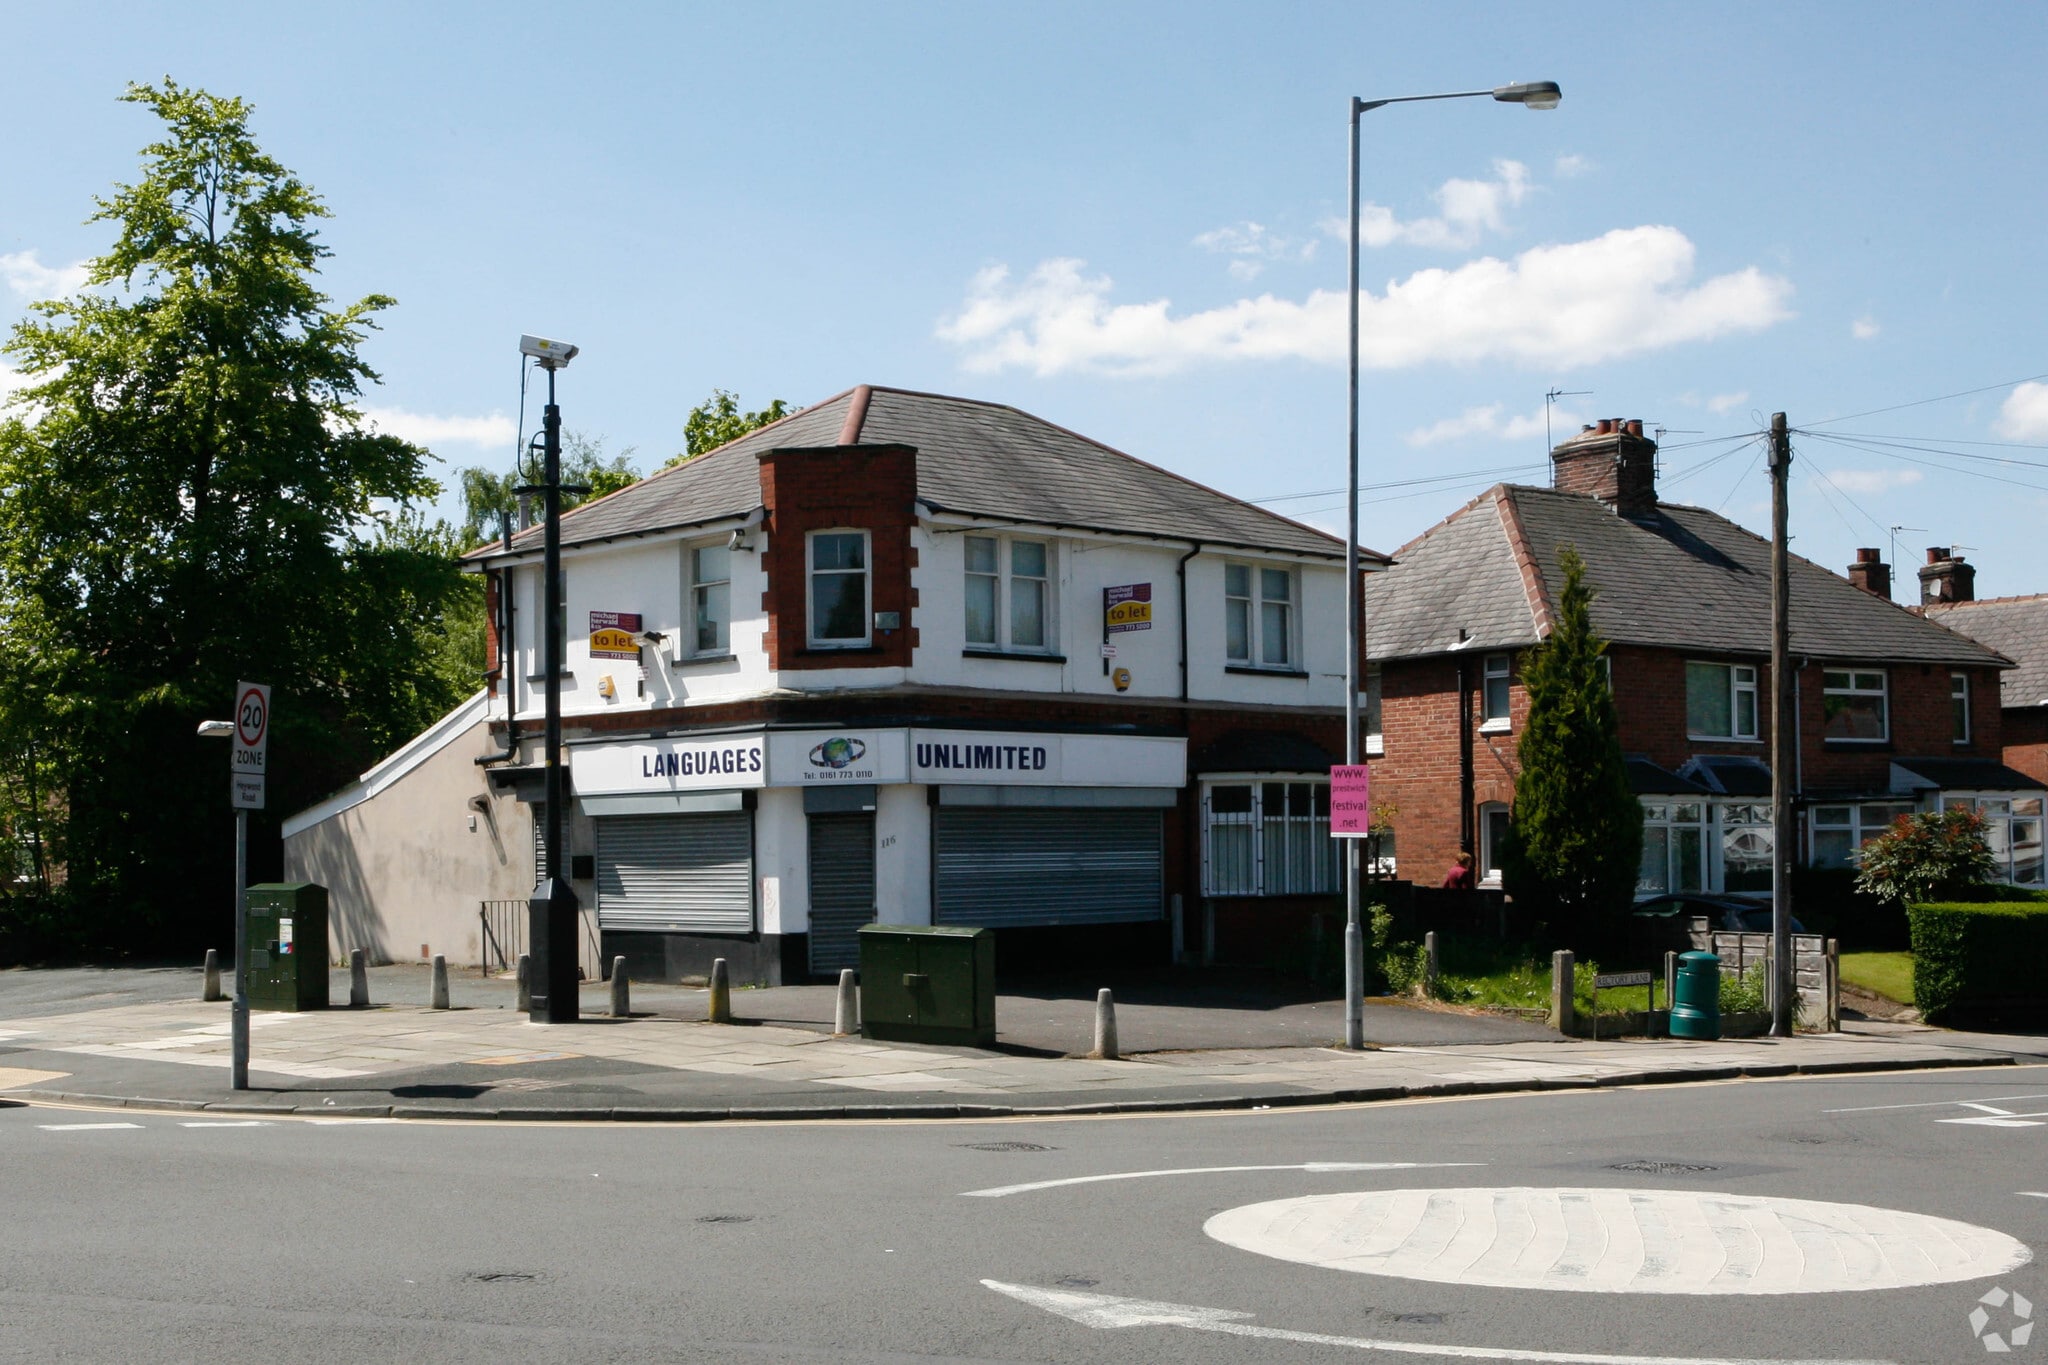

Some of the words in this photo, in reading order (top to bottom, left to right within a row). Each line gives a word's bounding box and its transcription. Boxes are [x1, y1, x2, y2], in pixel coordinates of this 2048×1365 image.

[1111, 608, 1125, 619] to
[1128, 606, 1147, 618] let
[594, 634, 609, 646] to
[614, 634, 634, 647] let
[242, 704, 262, 729] 20
[236, 750, 263, 766] ZONE
[643, 747, 762, 778] LANGUAGES
[916, 743, 1047, 771] UNLIMITED
[803, 772, 817, 780] Tel:
[839, 771, 853, 779] 773
[856, 770, 873, 778] 0110
[1333, 769, 1366, 779] www.
[1332, 784, 1367, 793] prestwich
[1332, 800, 1367, 811] festival
[1340, 818, 1358, 828] .net
[881, 834, 897, 849] 116
[1597, 975, 1628, 986] RECTORY
[1630, 973, 1649, 983] LANE
